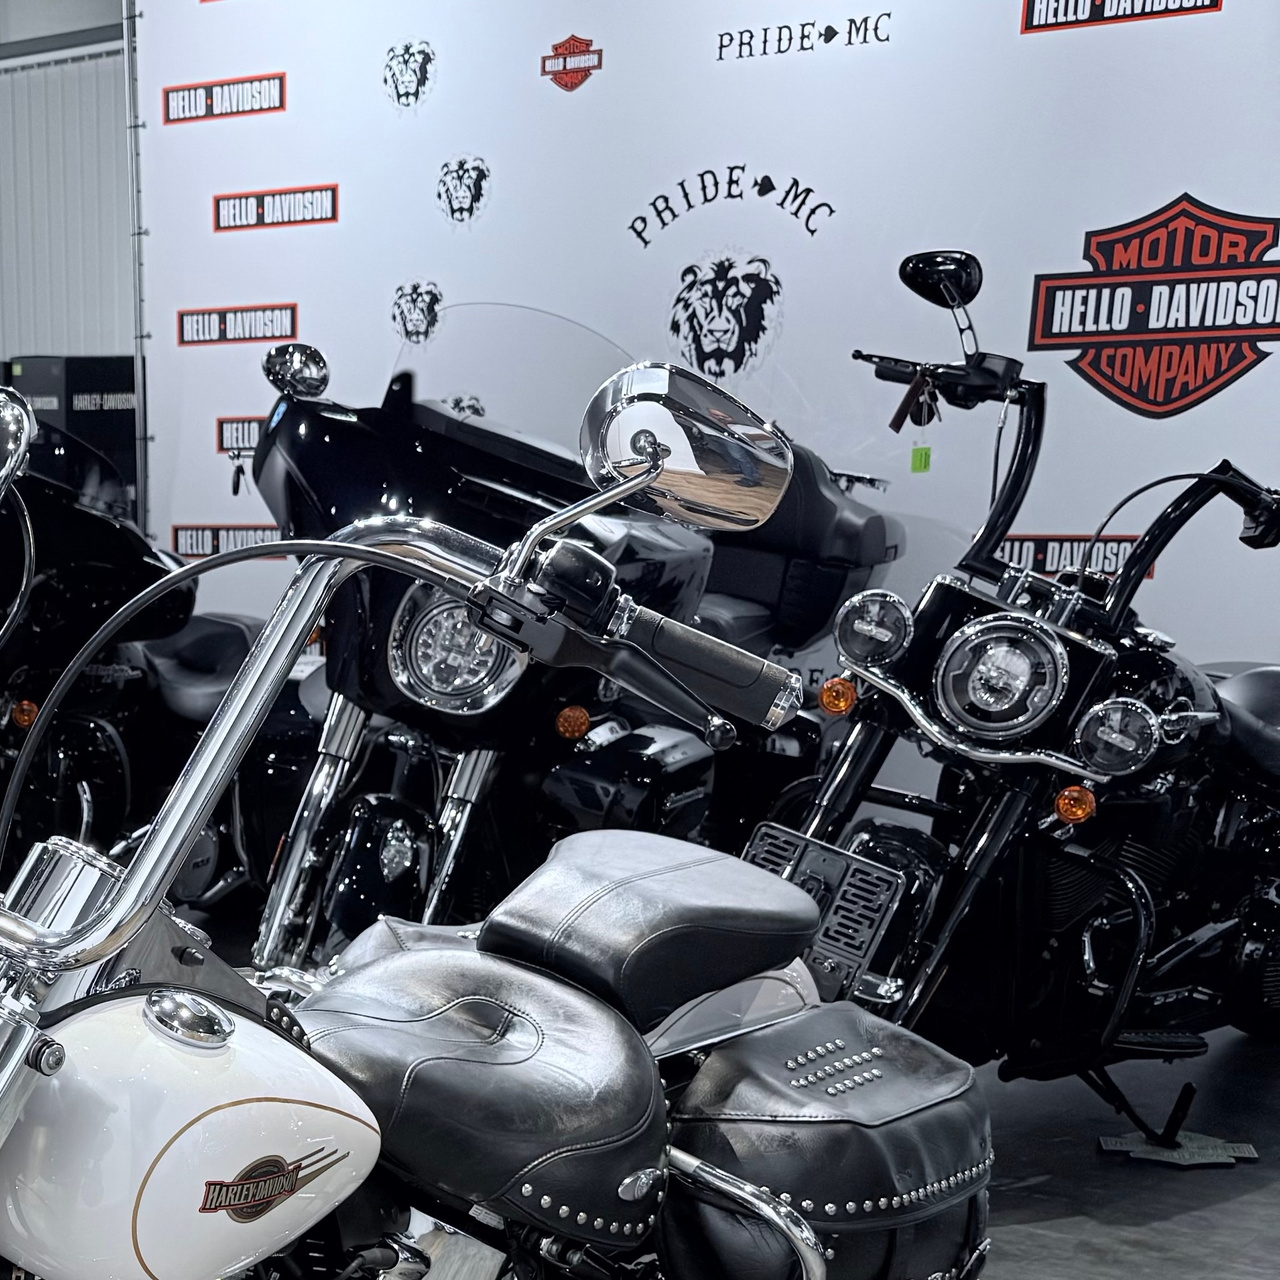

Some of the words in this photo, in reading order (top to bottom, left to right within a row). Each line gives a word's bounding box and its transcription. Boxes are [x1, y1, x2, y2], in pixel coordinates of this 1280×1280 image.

[716, 20, 816, 61] PRIDE
[844, 11, 892, 46] MC
[168, 87, 207, 120] HELLO
[212, 78, 280, 115] DAVIDSON
[219, 196, 257, 228] HELLO
[263, 189, 332, 224] DAVIDSON
[627, 163, 746, 249] PRIDE
[776, 177, 836, 237] MC
[1112, 215, 1247, 270] MOTOR
[183, 313, 220, 342] HELLO
[226, 308, 292, 340] DAVIDSON
[1052, 286, 1132, 334] HELLO
[1100, 342, 1236, 402] COMPANY
[222, 421, 260, 449] HELLO
[177, 529, 213, 555] HELLO
